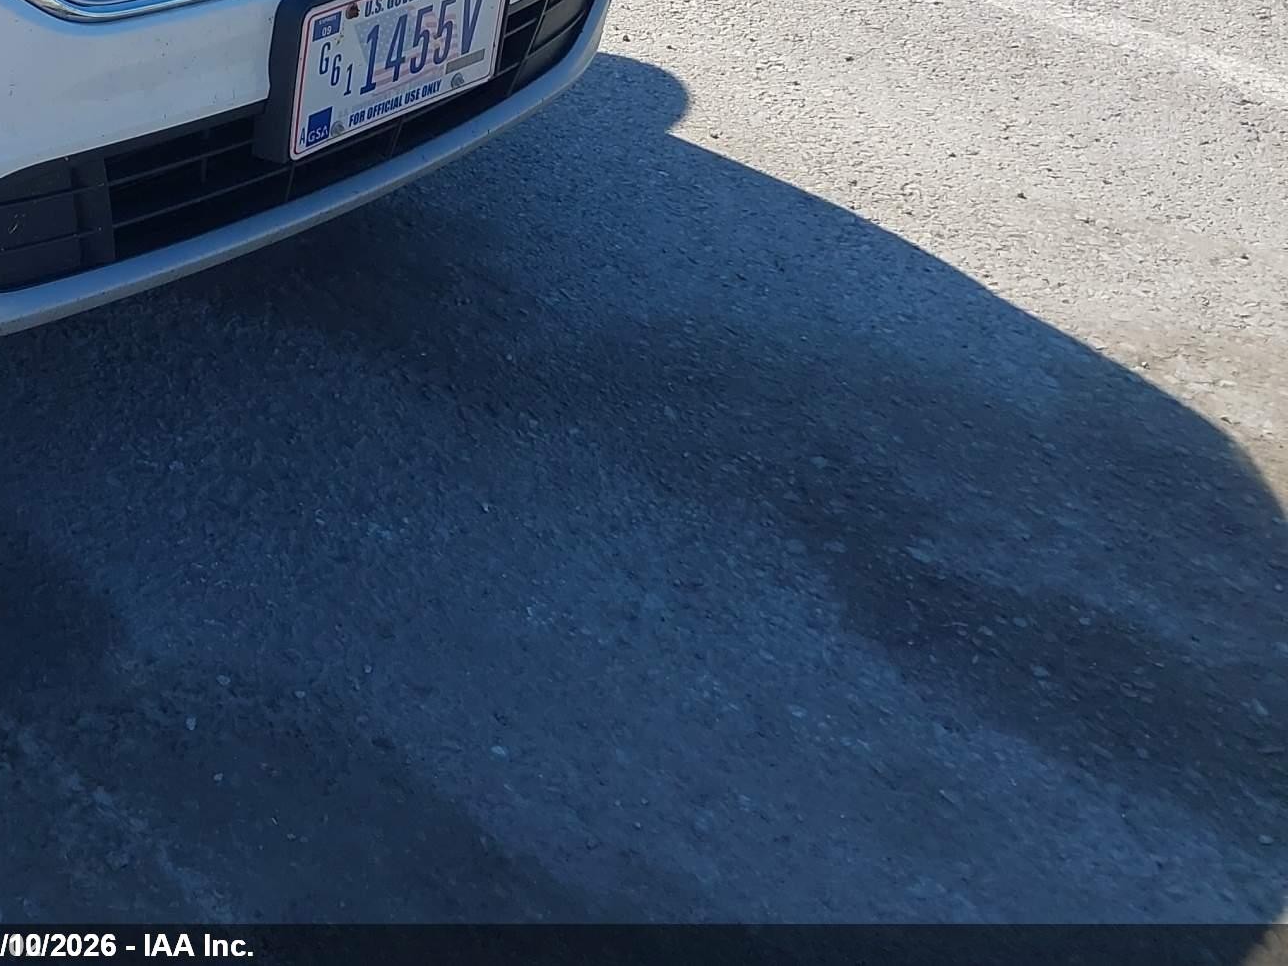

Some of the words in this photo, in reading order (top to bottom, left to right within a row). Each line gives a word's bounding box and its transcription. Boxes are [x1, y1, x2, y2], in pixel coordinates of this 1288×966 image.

[321, 25, 332, 37] 09
[348, 110, 365, 127] FOR
[366, 98, 404, 120] OFFICIAL
[404, 88, 421, 105] USE
[421, 79, 442, 97] ONLY
[307, 125, 329, 142] GSA
